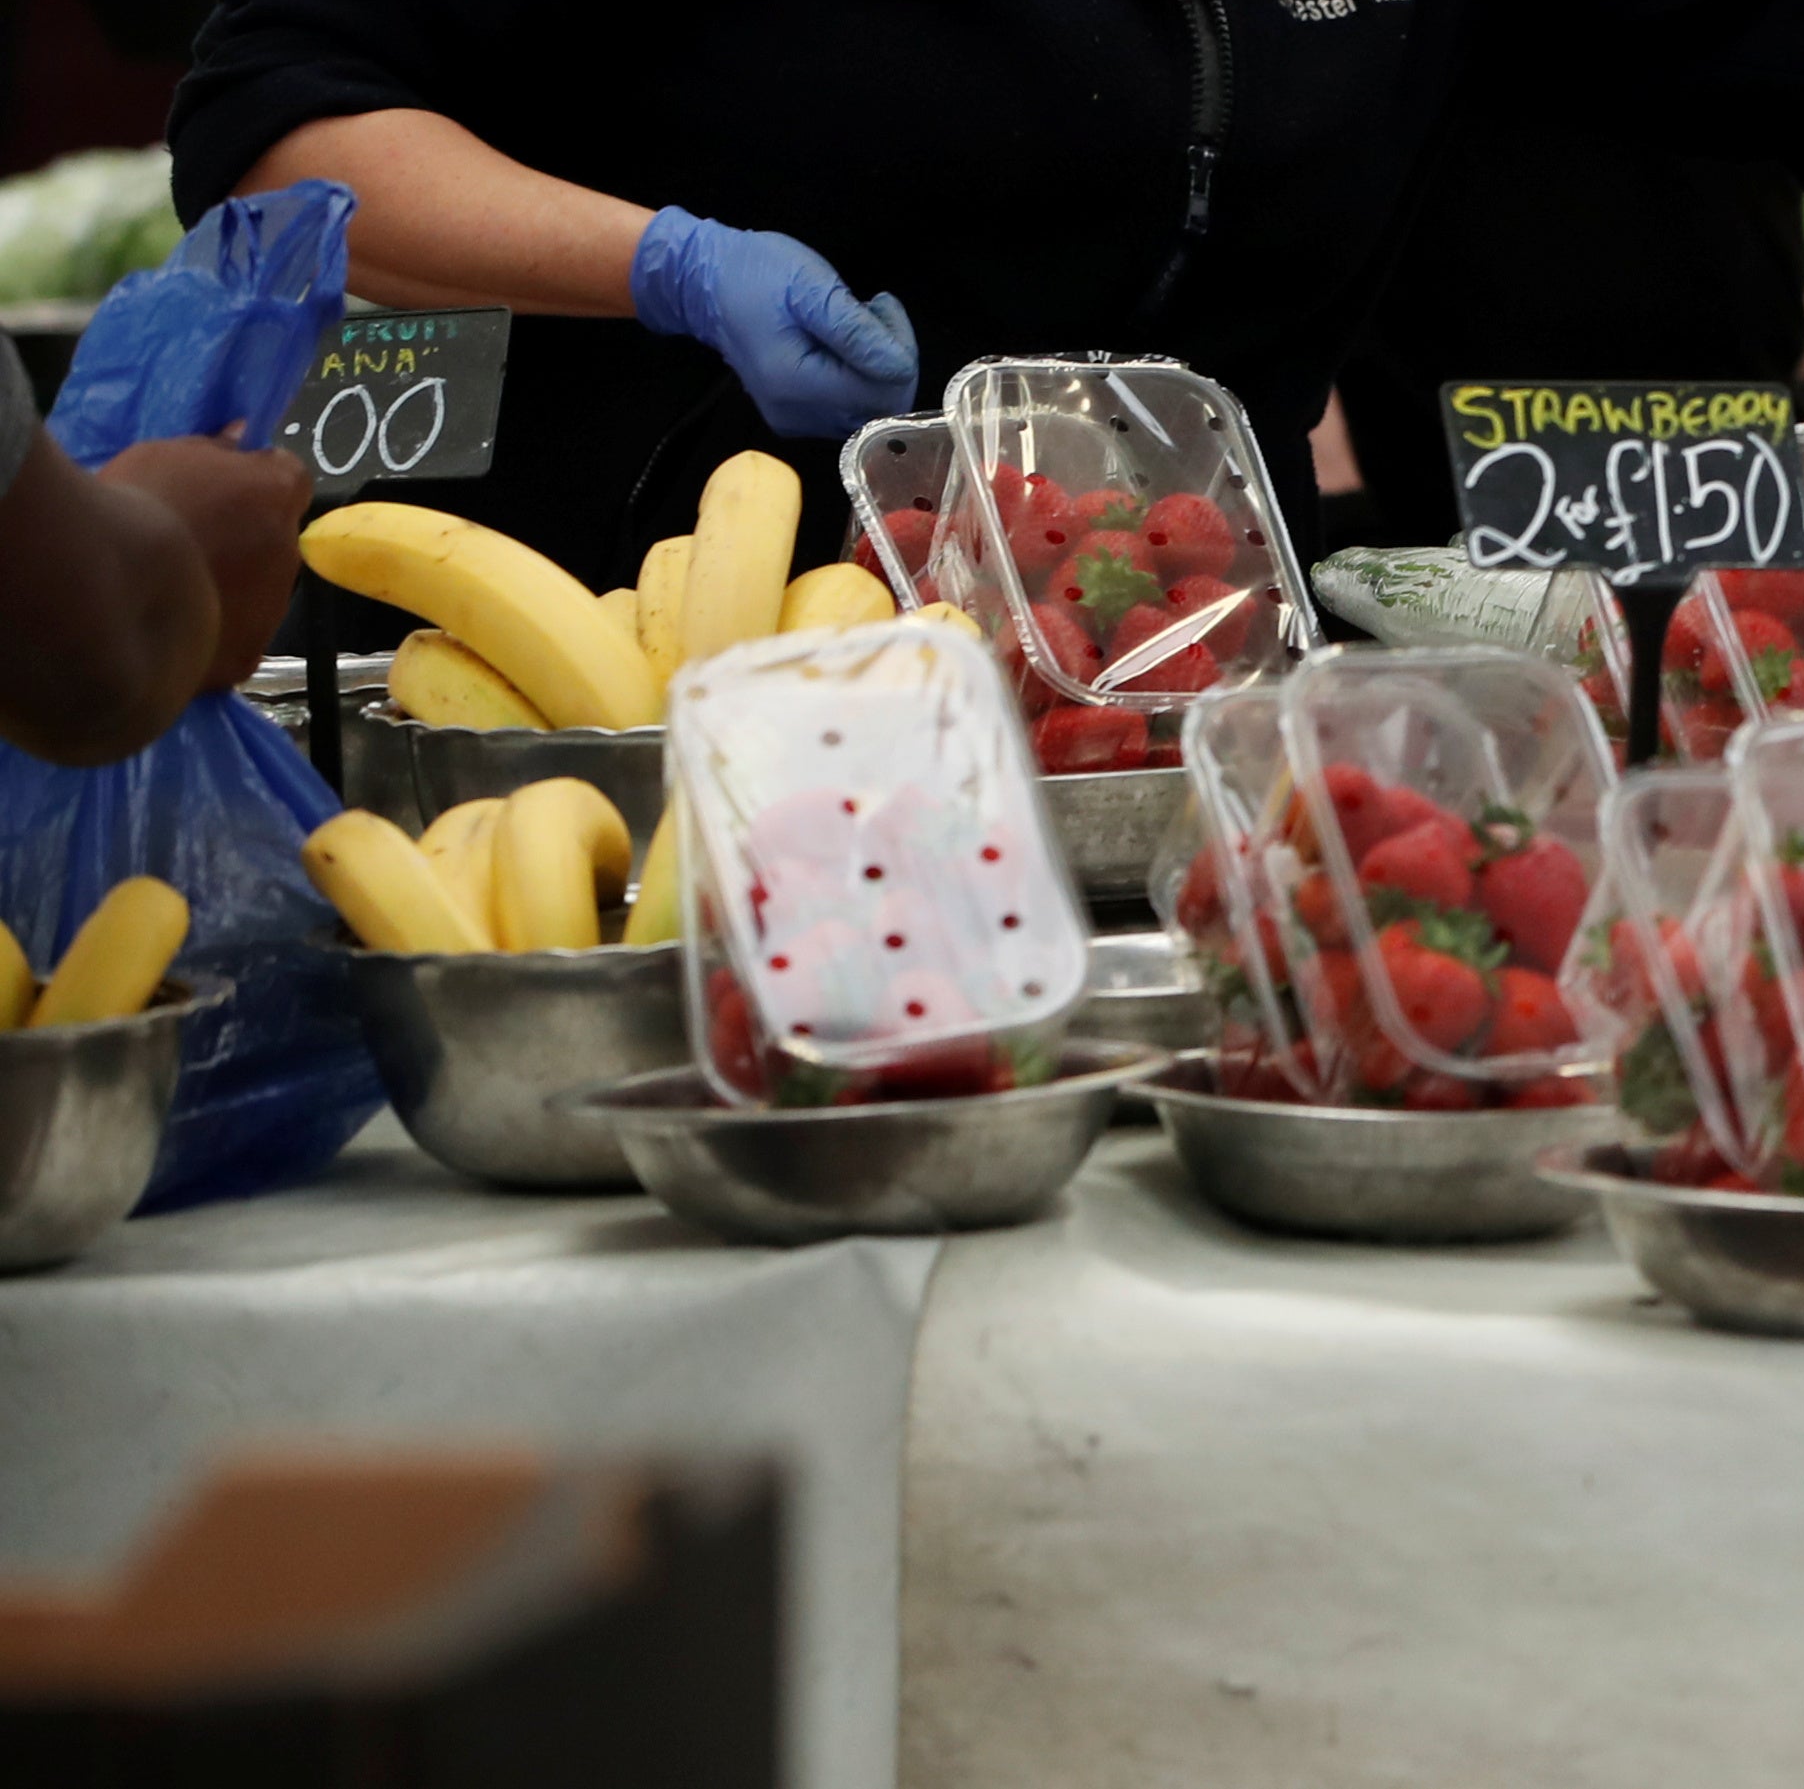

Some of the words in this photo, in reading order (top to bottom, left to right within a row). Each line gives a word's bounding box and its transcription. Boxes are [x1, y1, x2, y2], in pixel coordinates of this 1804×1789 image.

[284, 377, 447, 476] .00
[1451, 385, 1792, 450] STRAWBERRY
[1465, 442, 1567, 568] 2
[1602, 431, 1792, 587] £1.50
